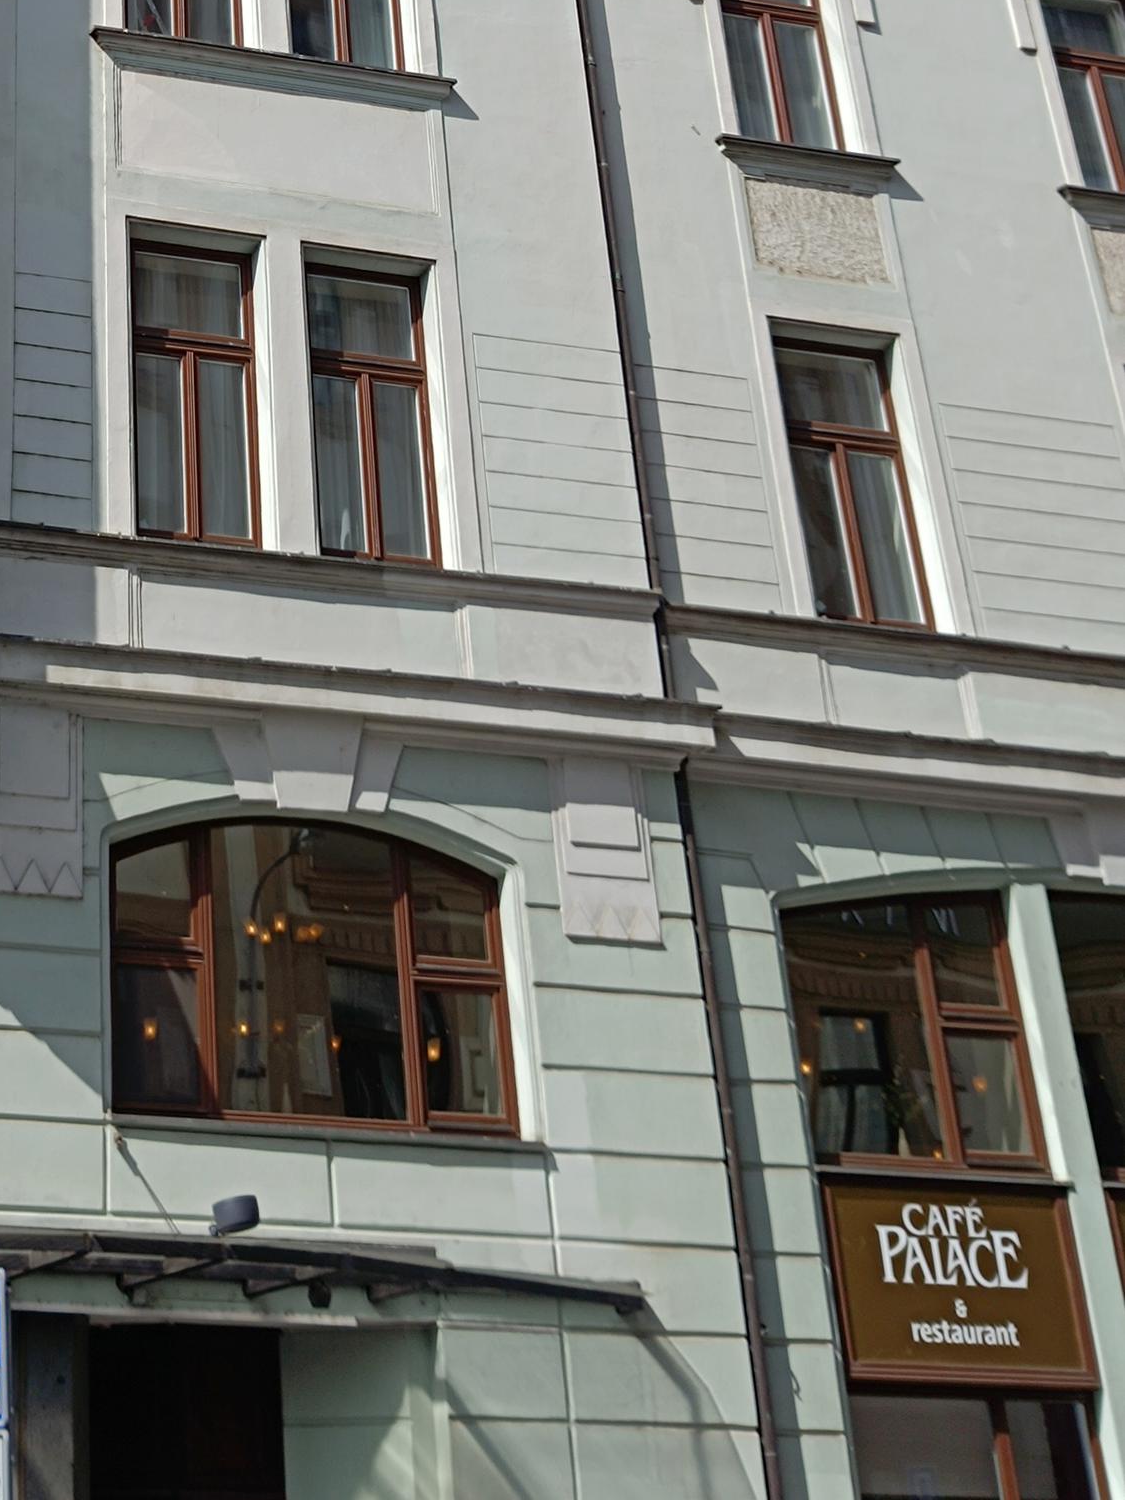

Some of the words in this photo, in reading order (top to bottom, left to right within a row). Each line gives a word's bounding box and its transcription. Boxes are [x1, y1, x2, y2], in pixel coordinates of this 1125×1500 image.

[901, 1198, 987, 1238] CAFÉ
[875, 1223, 1029, 1289] PALACE
[954, 1298, 968, 1318] &
[910, 1320, 1020, 1347] restaurant
